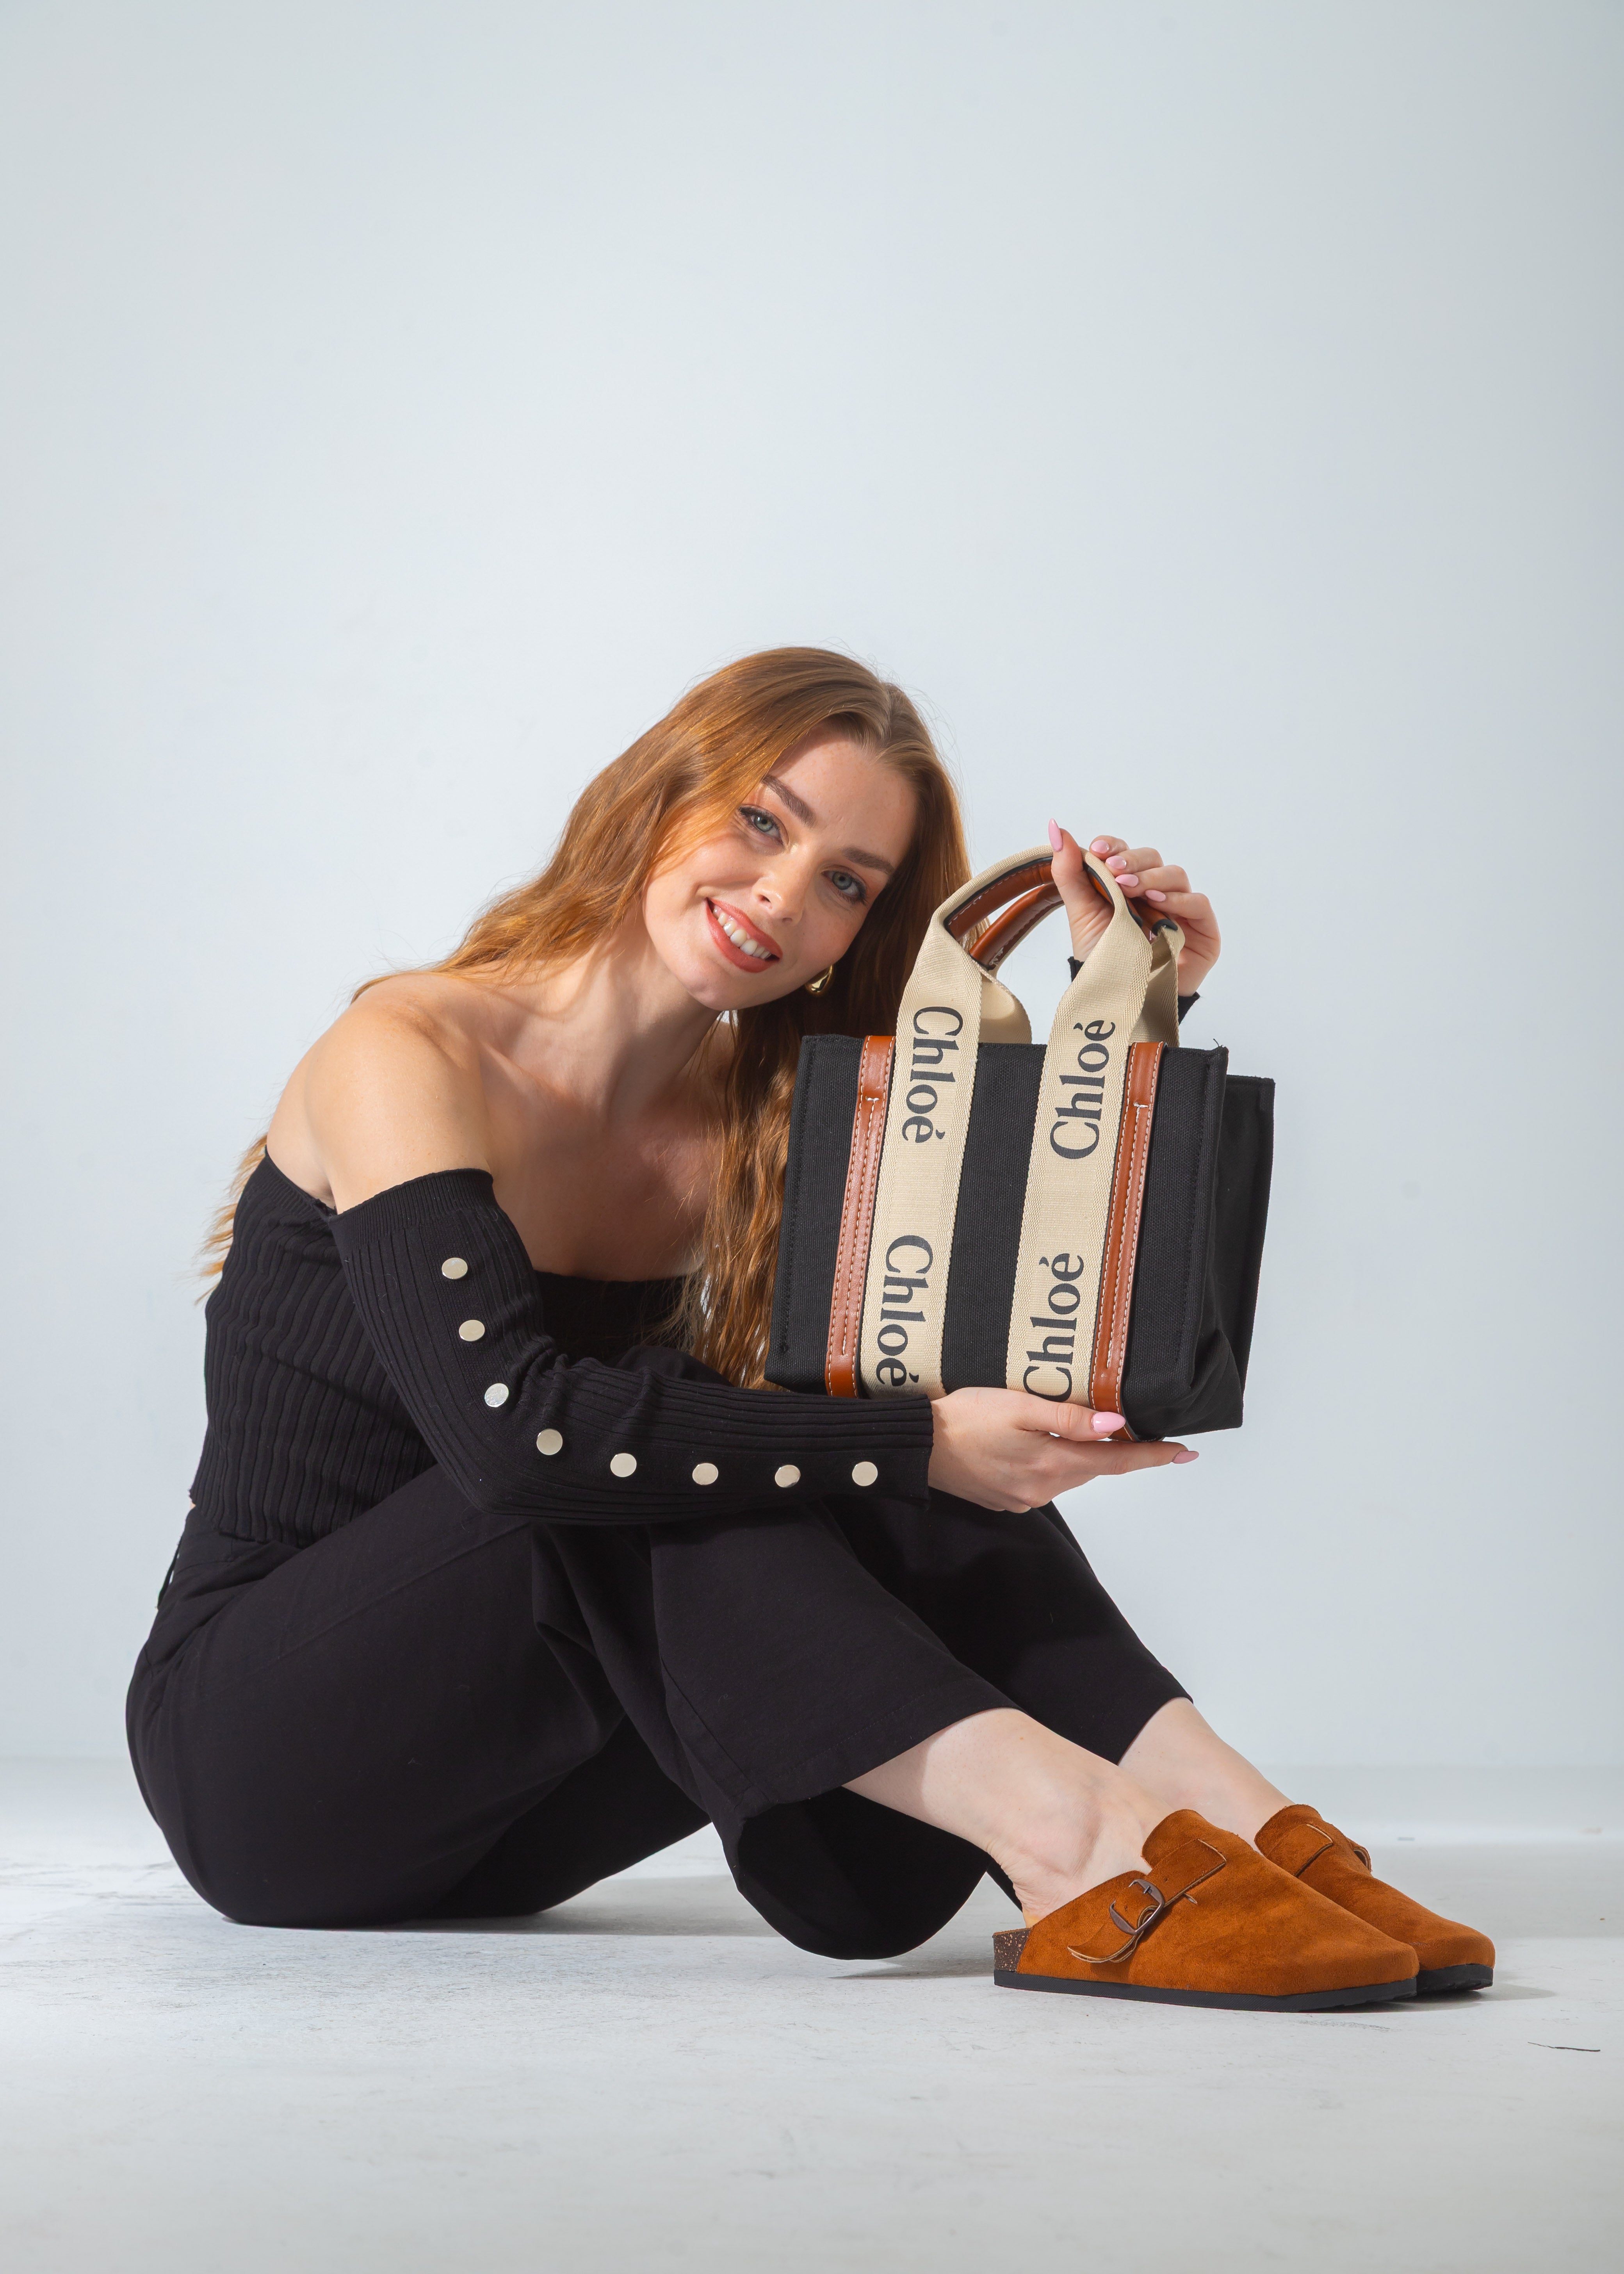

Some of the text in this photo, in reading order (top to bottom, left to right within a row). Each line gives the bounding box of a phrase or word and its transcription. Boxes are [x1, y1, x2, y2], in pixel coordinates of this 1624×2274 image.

[902, 1006, 963, 1143] Chloé
[1050, 1019, 1116, 1159] Chloé
[876, 1235, 933, 1386] Chloé
[1023, 1253, 1084, 1403] Chloé
